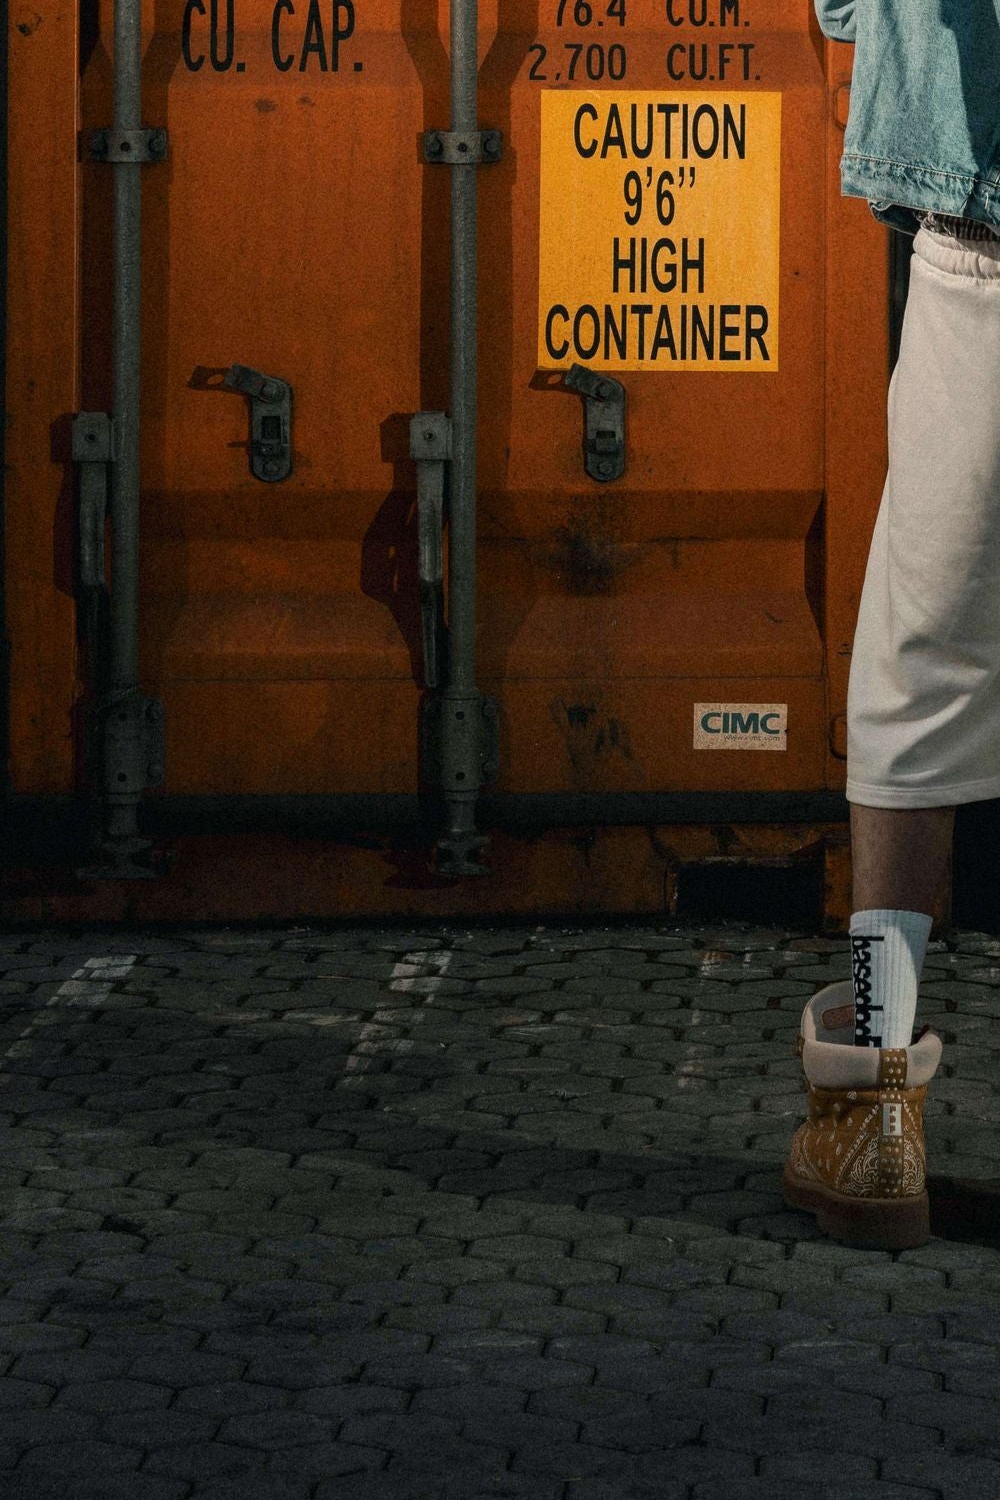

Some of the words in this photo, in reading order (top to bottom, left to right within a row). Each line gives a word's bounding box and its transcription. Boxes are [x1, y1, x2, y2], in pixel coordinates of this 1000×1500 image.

[527, 44, 626, 80] 2,700
[667, 44, 760, 80] CU.FT.
[574, 104, 745, 159] CAUTION
[613, 238, 704, 293] HIGH
[546, 305, 770, 361] CONTAINER
[701, 713, 779, 734] CIMC
